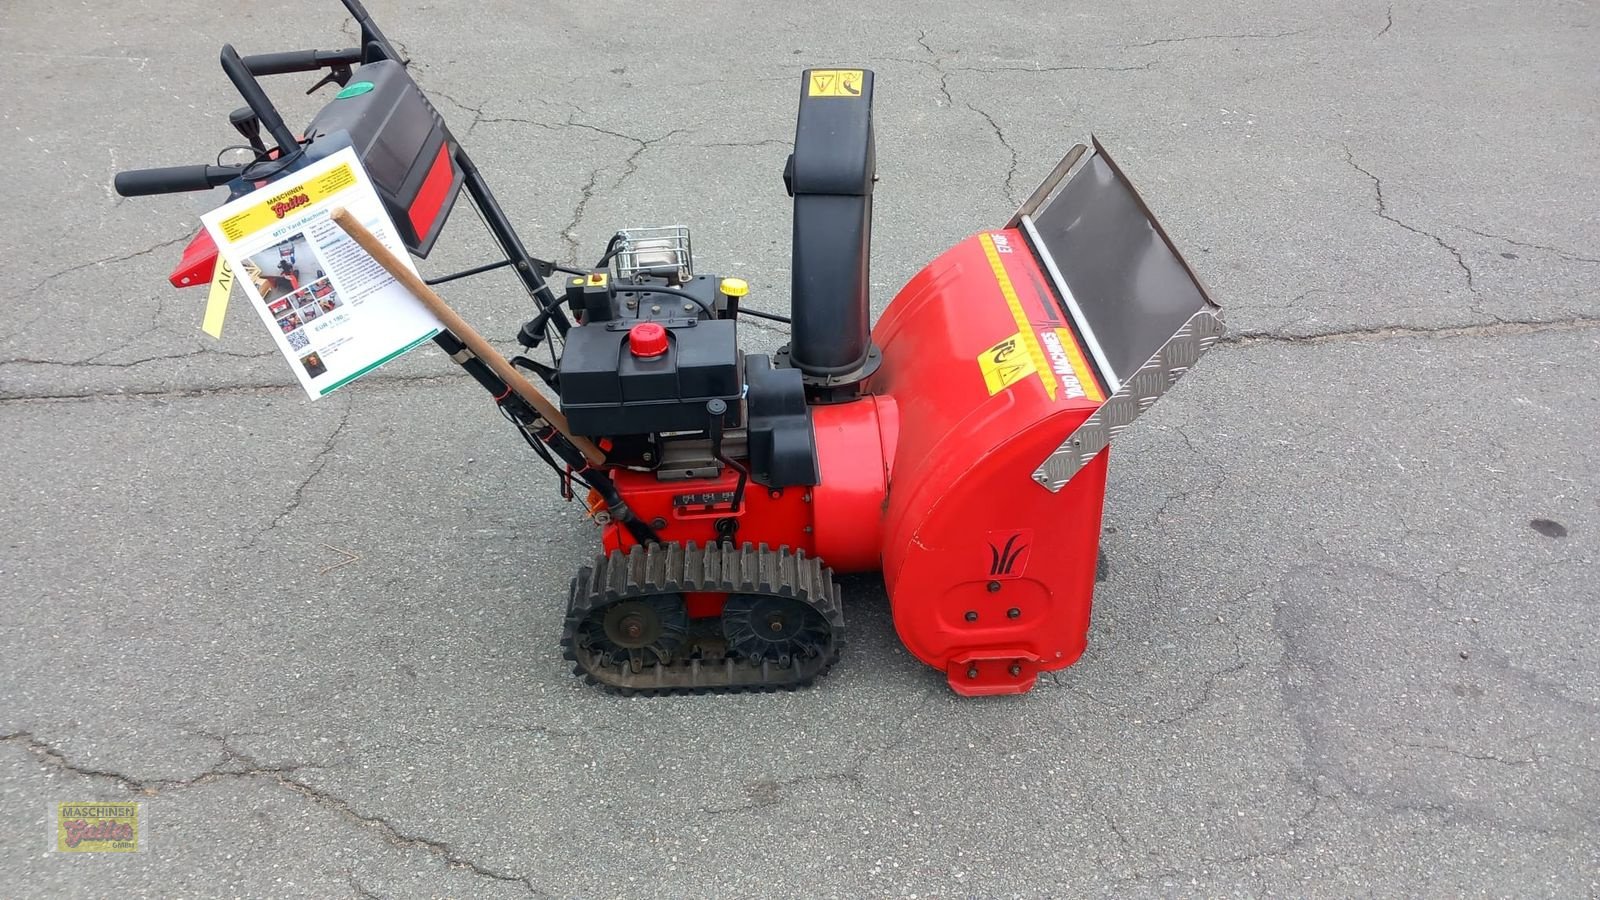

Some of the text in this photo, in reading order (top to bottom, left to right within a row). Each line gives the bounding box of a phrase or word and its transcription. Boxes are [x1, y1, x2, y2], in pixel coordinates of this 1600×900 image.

[266, 185, 304, 206] MASCHINEN
[272, 227, 287, 238] MTD
[287, 220, 301, 231] Yard
[302, 208, 329, 224] Machines
